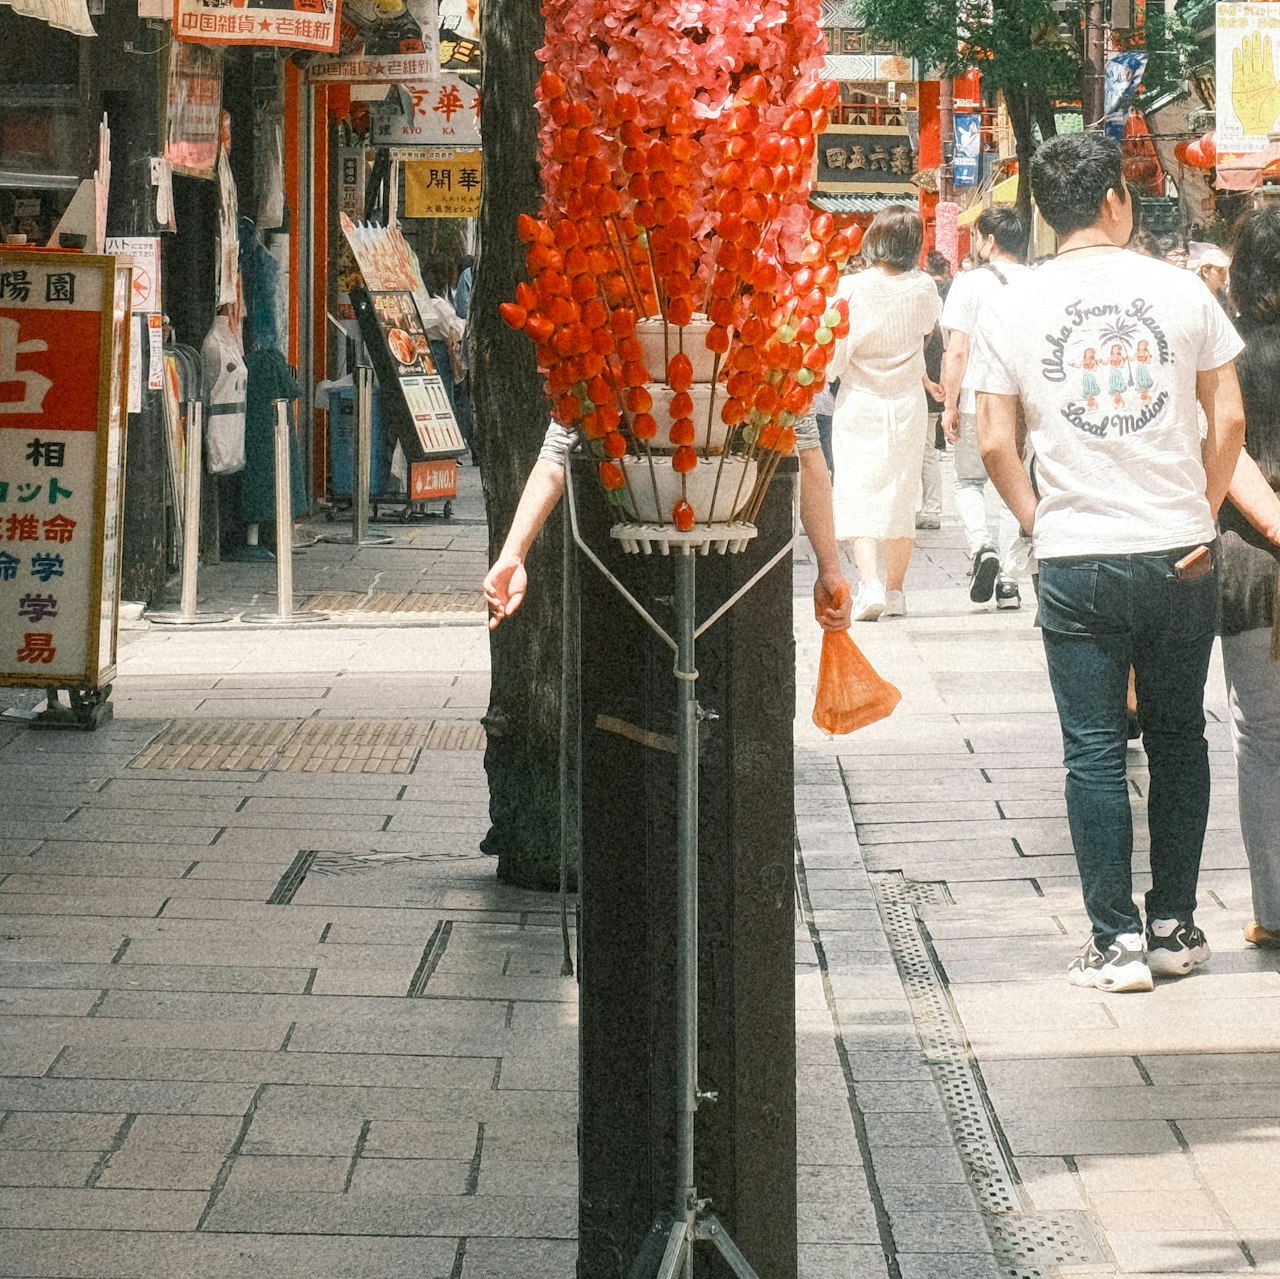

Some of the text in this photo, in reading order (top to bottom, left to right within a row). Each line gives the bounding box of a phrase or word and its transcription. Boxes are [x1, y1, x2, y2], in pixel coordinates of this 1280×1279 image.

[402, 126, 455, 135] KYO KA
[1041, 297, 1176, 383] Aloha From Hawaii
[1060, 390, 1169, 439] Local Motion
